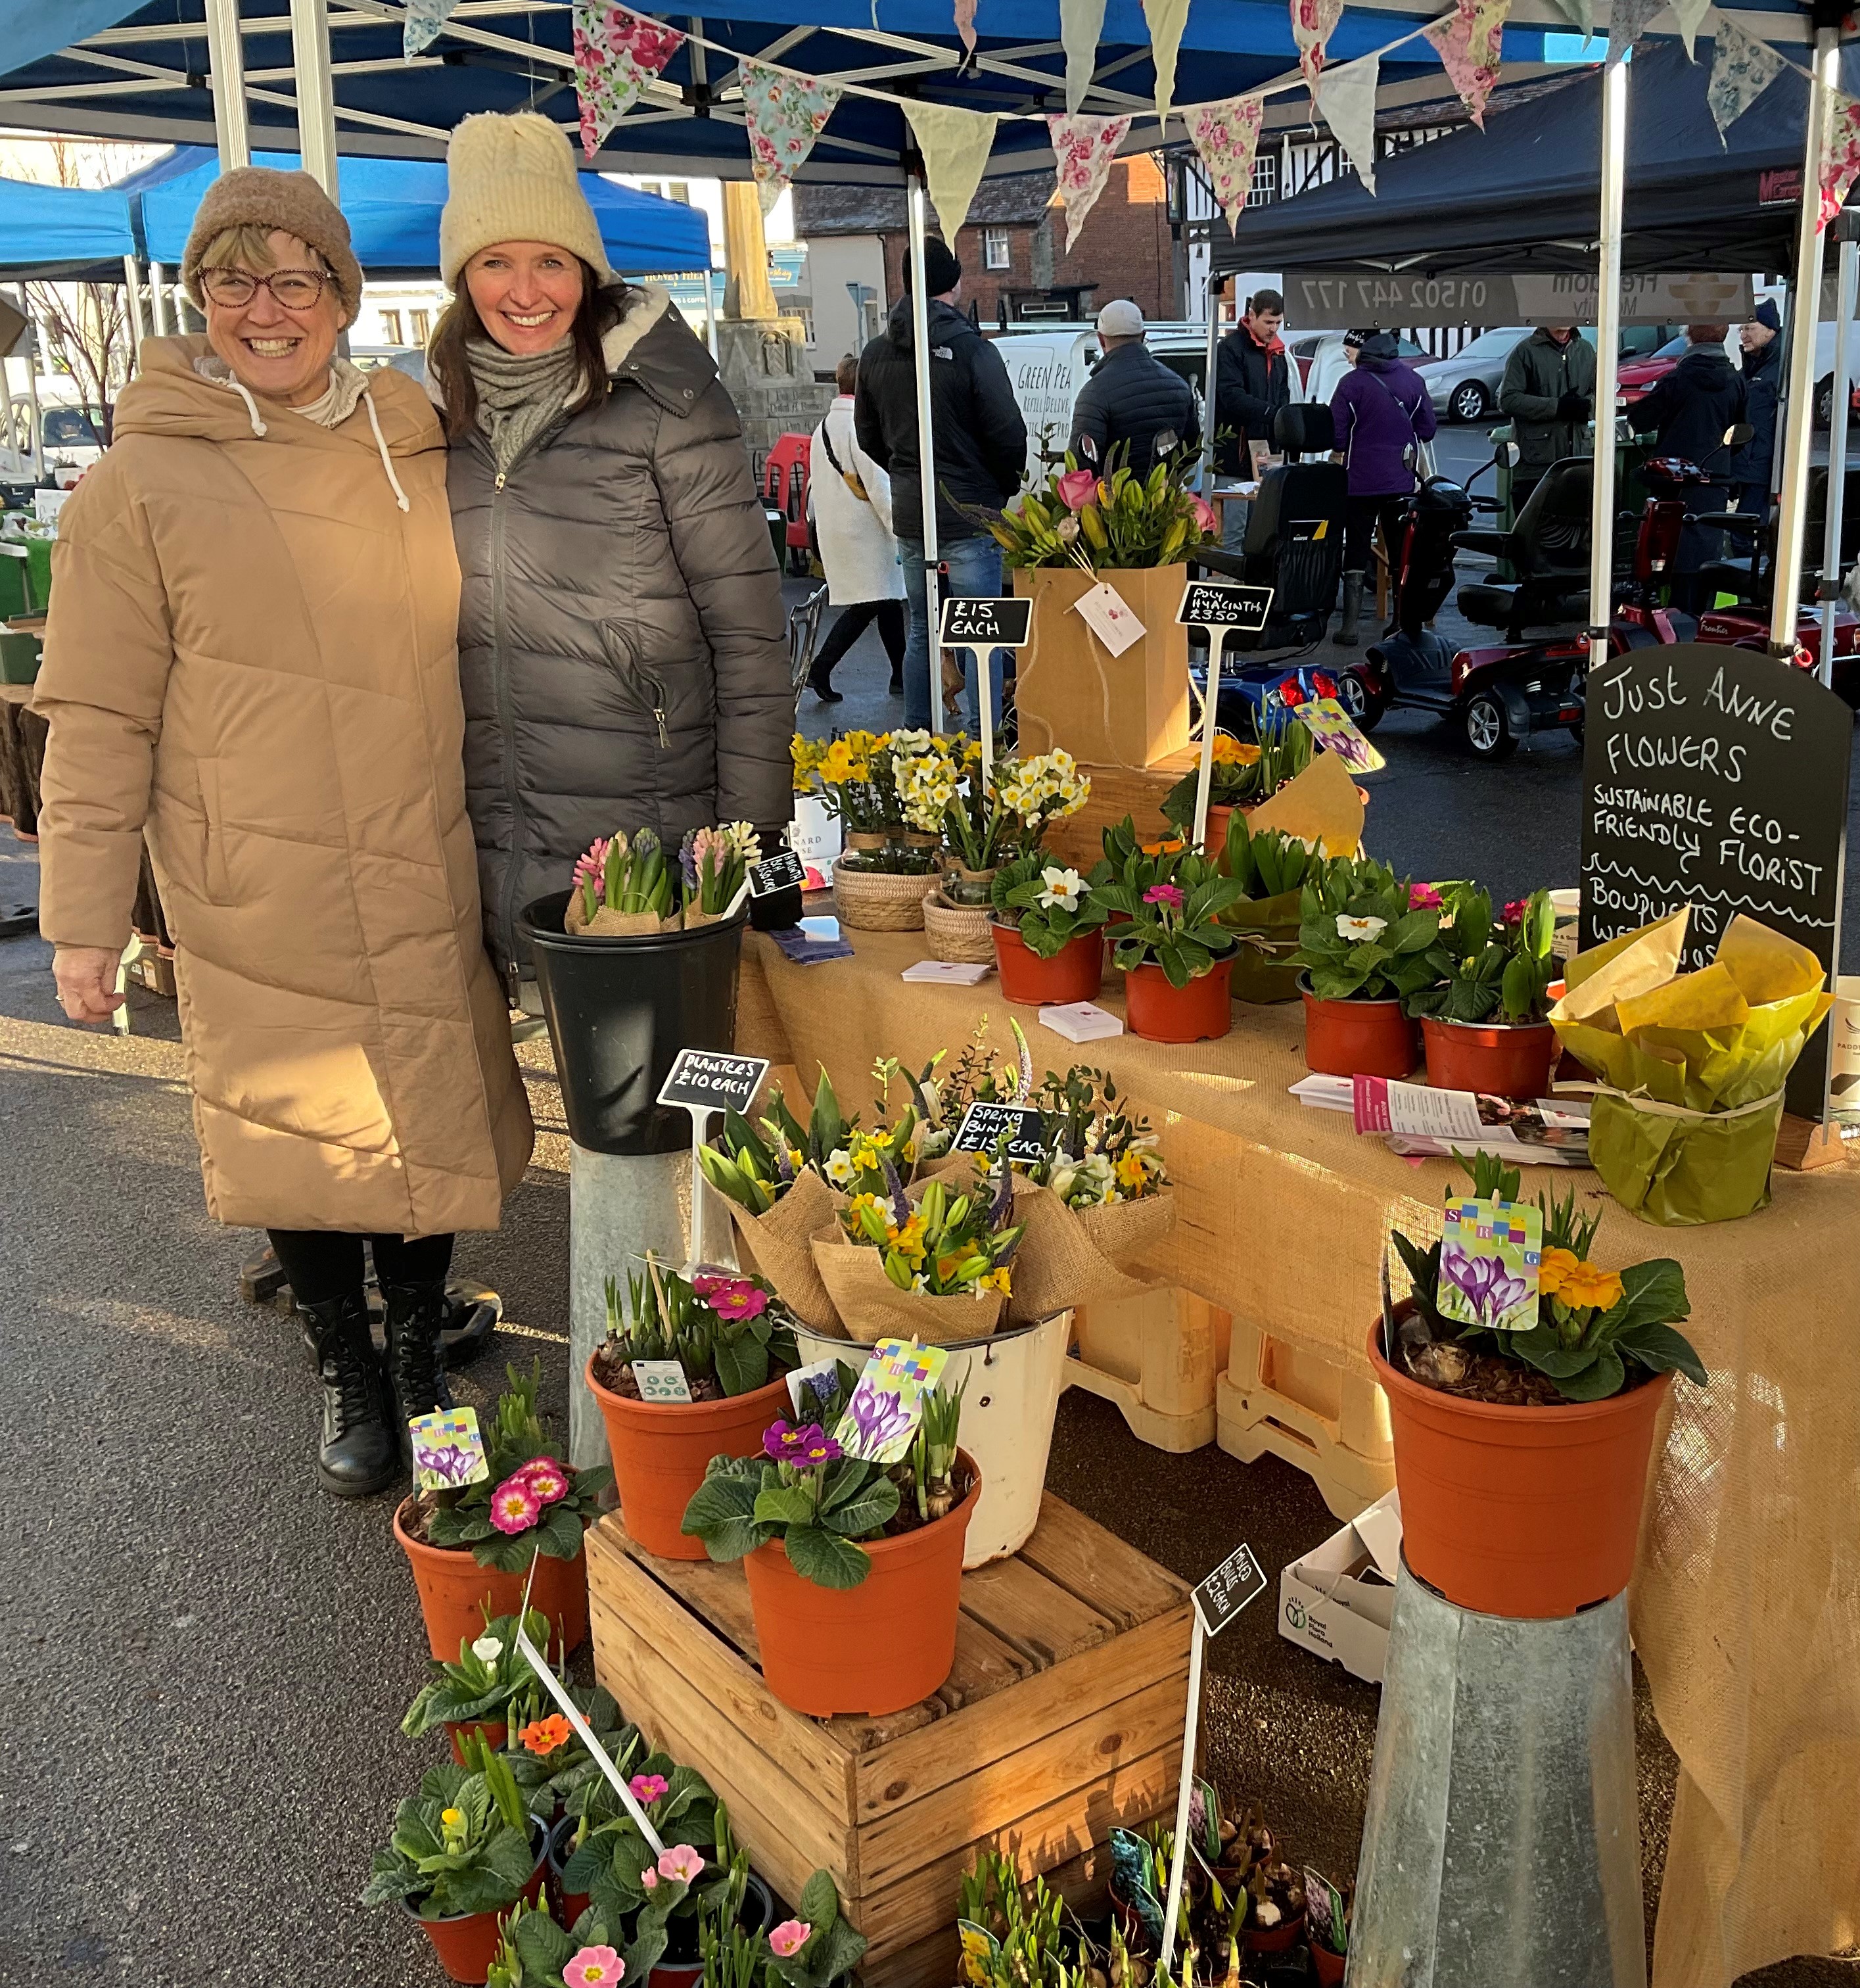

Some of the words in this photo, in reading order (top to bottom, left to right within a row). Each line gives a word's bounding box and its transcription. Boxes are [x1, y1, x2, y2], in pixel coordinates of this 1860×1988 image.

[1018, 363, 1052, 389] GREEN
[1054, 363, 1071, 389] PEA
[1023, 395, 1042, 413] REFILL
[1045, 395, 1071, 417] DELIVE
[1193, 588, 1224, 601] POLY
[954, 601, 994, 619] £15
[1190, 608, 1238, 621] £3.50
[1192, 599, 1263, 613] HYACINTH
[950, 620, 1000, 636] EACH
[1702, 666, 1796, 741] ANNE
[1606, 732, 1748, 784] FLOWERS
[1594, 784, 1713, 827] SUSTAINABLE
[1729, 806, 1801, 845] ECO-
[1593, 809, 1701, 874] FRIENDLY
[1720, 840, 1823, 897] FLORIST
[684, 1054, 755, 1077] PLANTERS
[675, 1068, 710, 1088] £10
[1308, 1615, 1327, 1630] Royal
[1308, 1622, 1325, 1636] Flora
[1308, 1630, 1334, 1648] Holland
